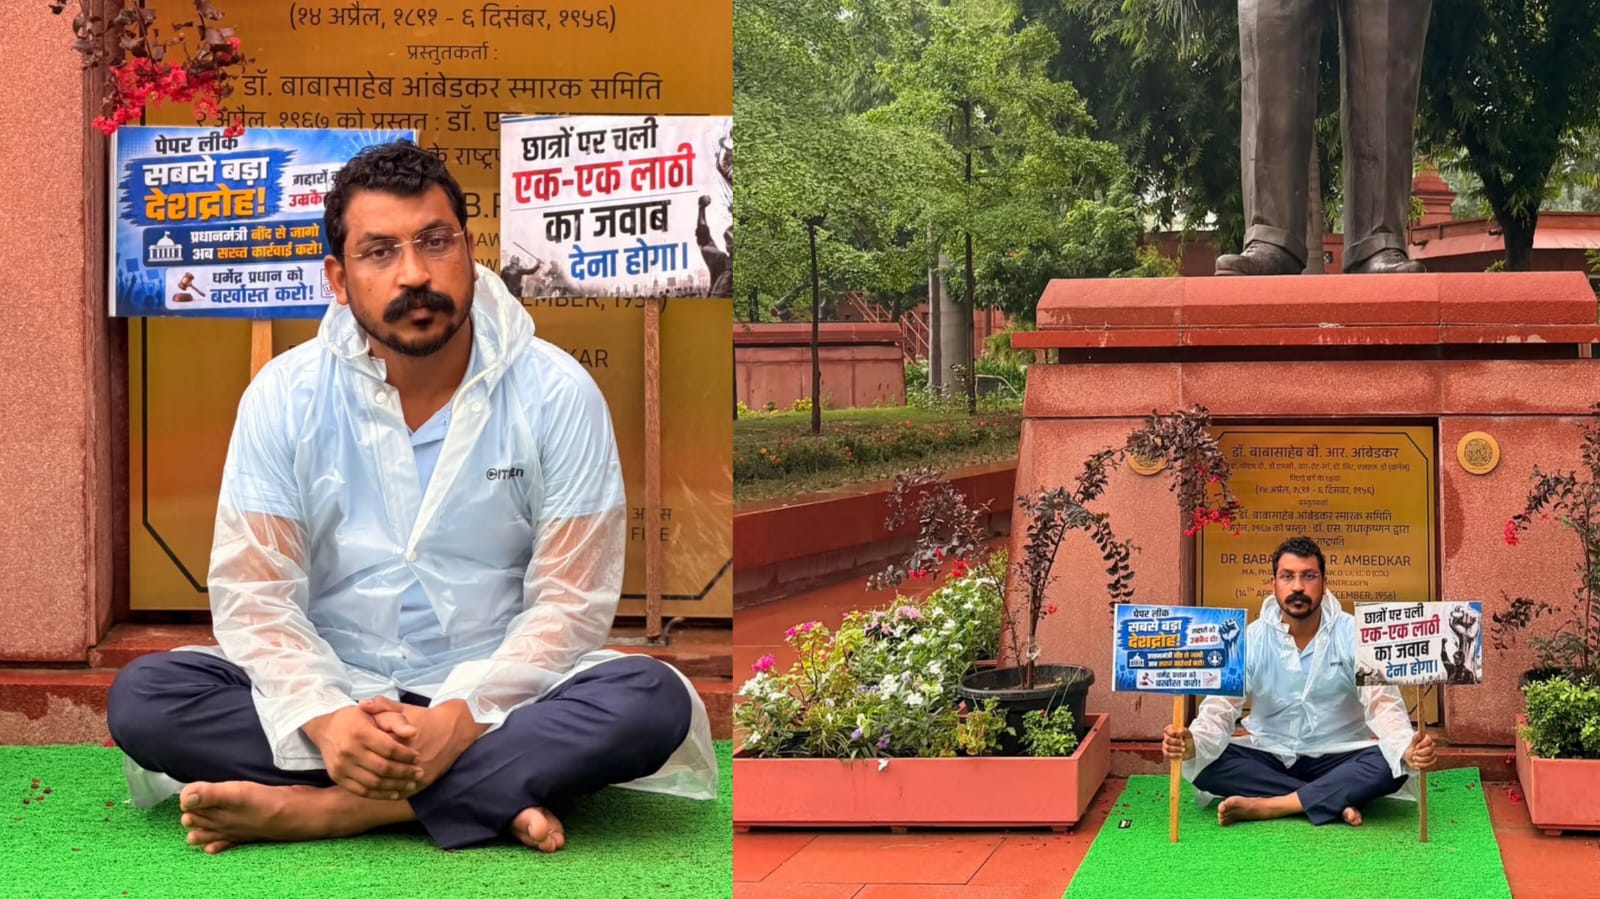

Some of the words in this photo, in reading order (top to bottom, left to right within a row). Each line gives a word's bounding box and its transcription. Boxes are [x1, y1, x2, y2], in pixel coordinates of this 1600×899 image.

[290, 5, 321, 31] (१४
[327, 2, 386, 30] अप्रैल,
[394, 8, 438, 27] १८९१
[462, 9, 475, 28] ६
[481, 3, 552, 31] दिसंबर,
[559, 5, 617, 32] १९५६)
[406, 42, 489, 65] प्रस्तुतकर्ता
[241, 69, 273, 97] डॉ.
[280, 70, 395, 99] बाबासाहेब
[402, 72, 501, 99] आंबेडकर
[507, 77, 583, 99] स्मारक
[589, 71, 663, 100] समिति
[335, 107, 365, 129] को
[447, 104, 476, 131] डॉ.
[155, 134, 193, 154] पेपर
[197, 131, 239, 152] लीक
[521, 126, 572, 162] छात्रों
[577, 130, 606, 155] पर
[611, 116, 659, 152] चली
[142, 154, 216, 187] सबसे
[220, 156, 270, 186] बड़ा
[512, 160, 623, 204] एक-एक
[628, 142, 696, 192] लाठी
[144, 183, 266, 222] देशद्रोह!
[543, 208, 584, 243] का
[590, 199, 672, 239] जवाब
[190, 228, 247, 245] प्रधानमंत्री
[251, 225, 272, 241] नींद
[275, 224, 286, 240] से
[290, 223, 320, 238] जागो
[192, 247, 213, 261] अब
[217, 245, 247, 260] सख्त
[252, 242, 292, 258] कार्रवाई
[295, 241, 323, 255] करो!
[569, 245, 618, 281] देना
[624, 238, 689, 275] होगा।
[248, 269, 282, 284] प्रधान
[287, 266, 304, 281] को
[210, 284, 269, 305] बर्खास्त
[275, 281, 314, 302] करो!
[1250, 444, 1304, 459] बाबासाहेब
[1351, 445, 1400, 459] आंबेडकर
[631, 527, 670, 542] FIE
[1344, 554, 1411, 567] AMBEDKAR
[1364, 607, 1387, 624] छात्रों
[1389, 608, 1402, 621] पर
[1403, 602, 1424, 619] चली
[1360, 622, 1409, 644] एक-एक
[1411, 614, 1440, 637] लाठी
[1374, 644, 1392, 661] का
[1395, 640, 1430, 659] जवाब
[1385, 662, 1407, 678] देना
